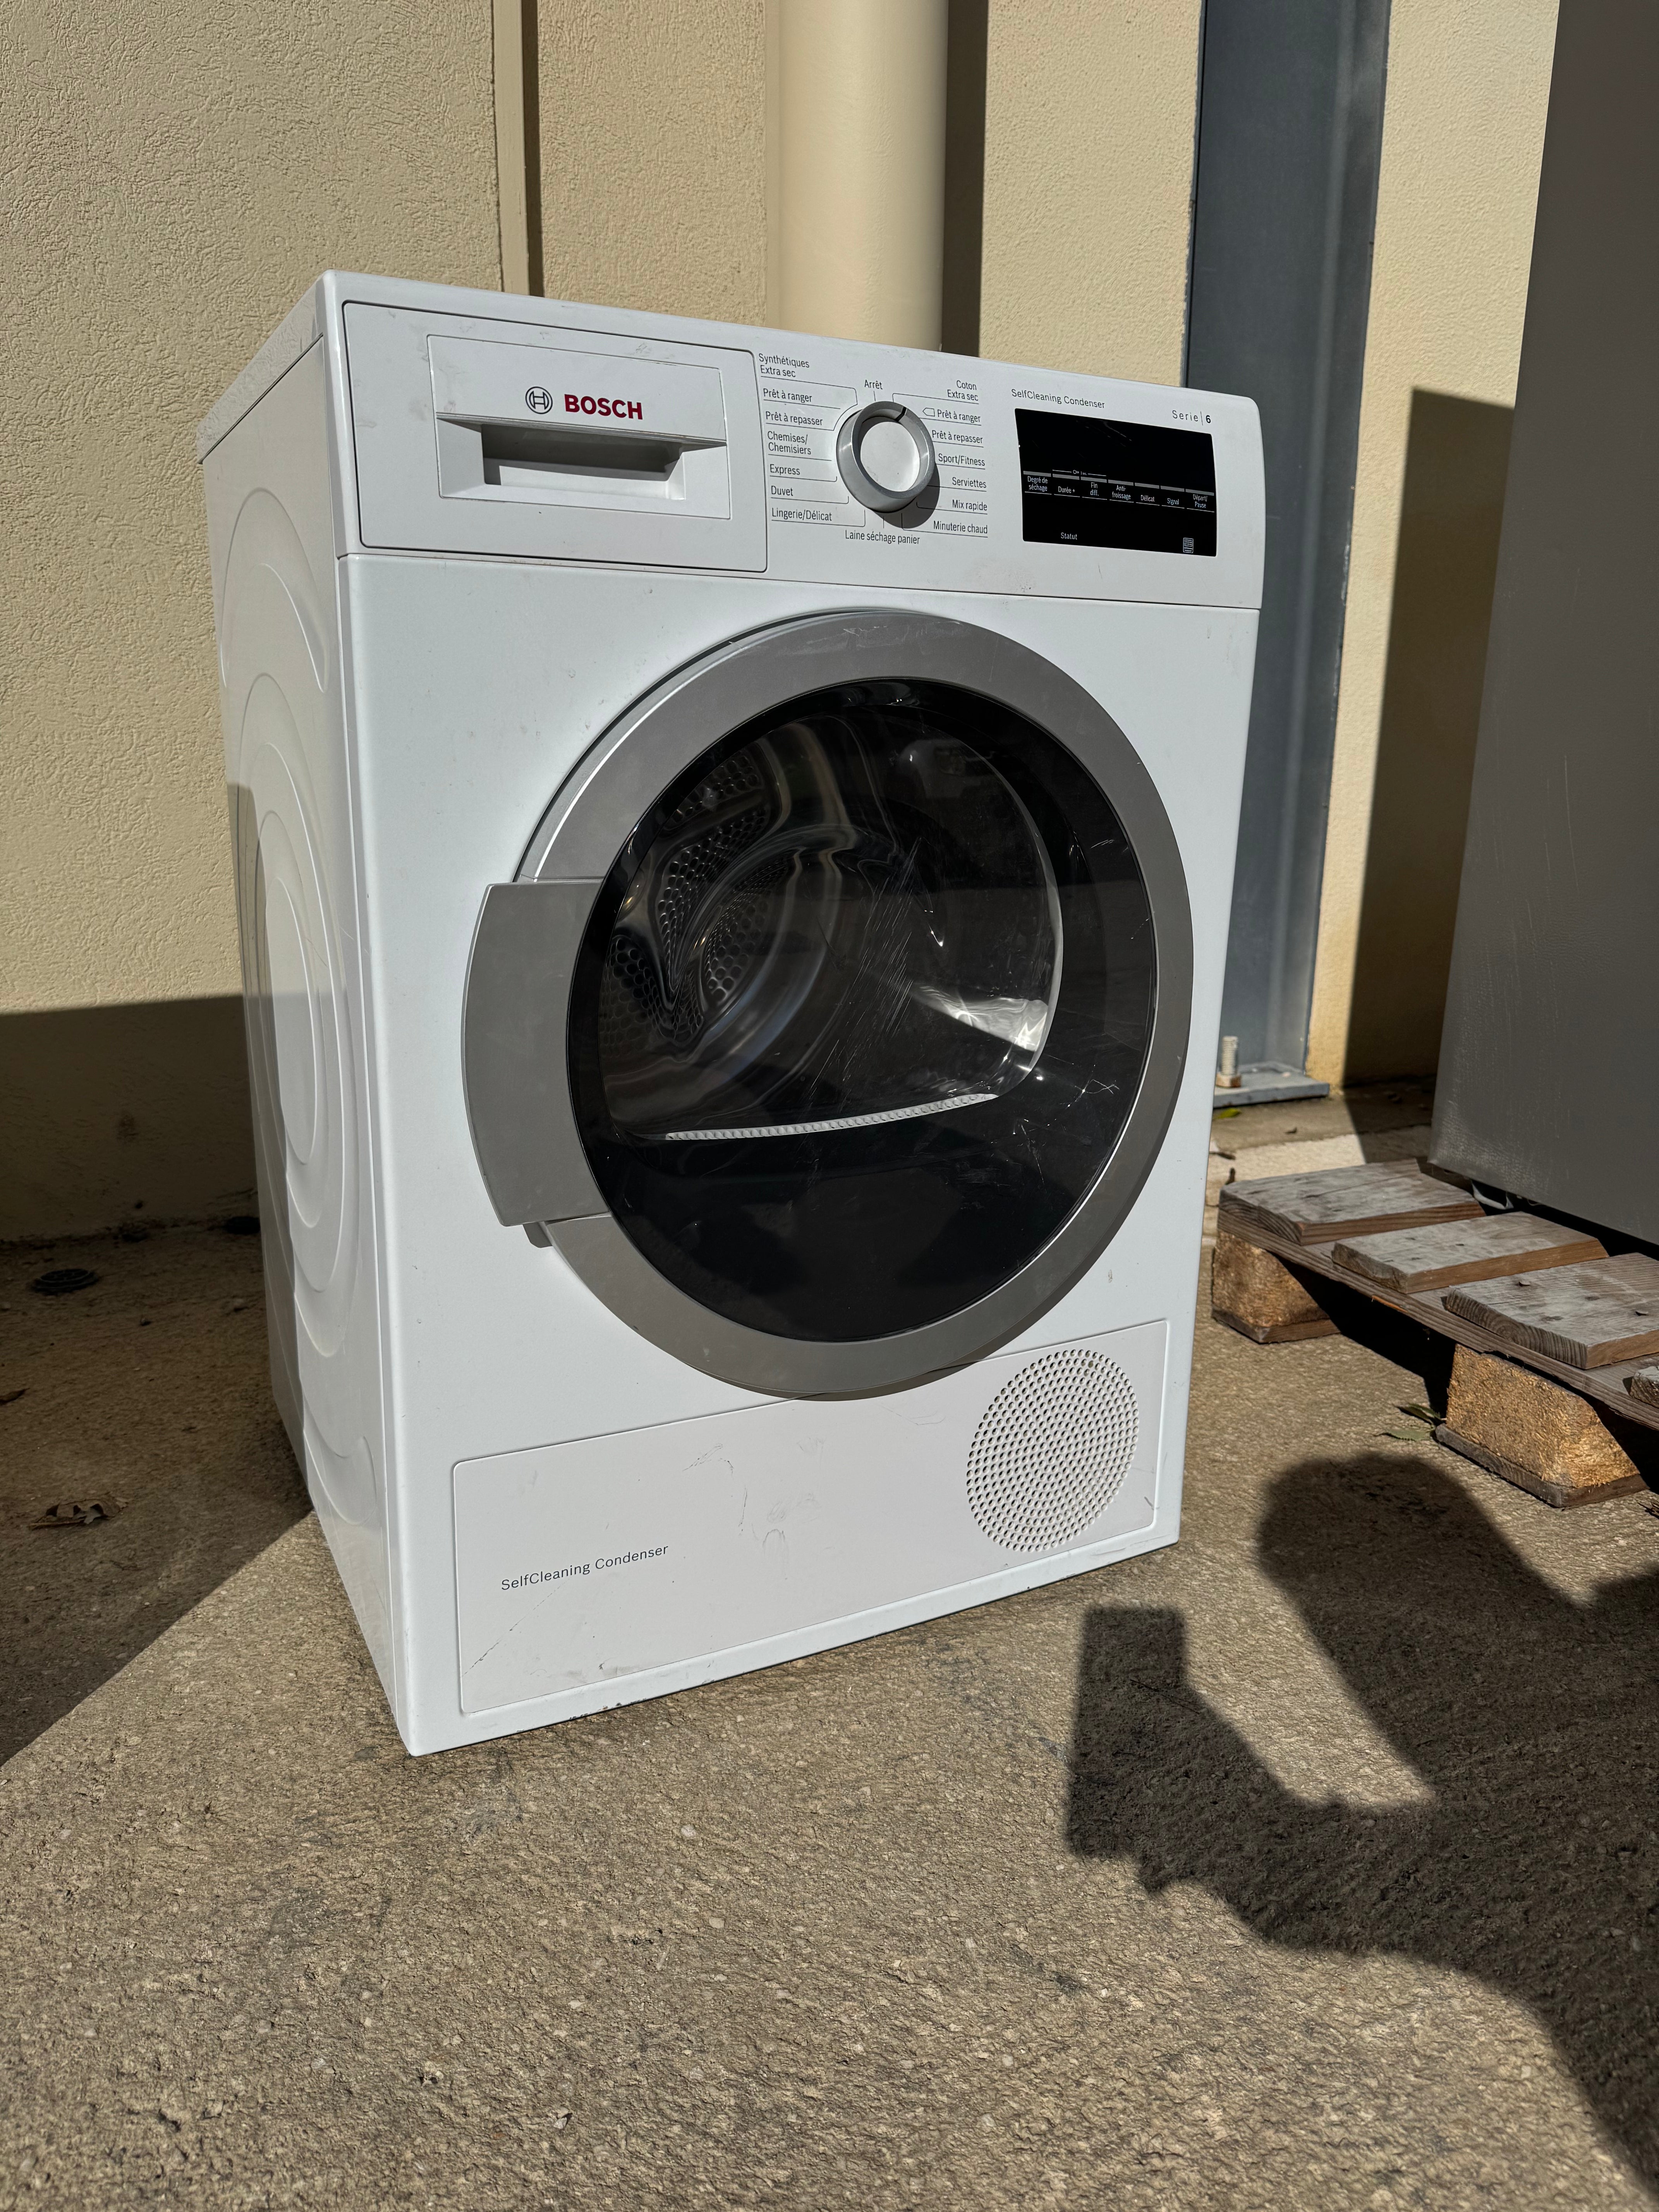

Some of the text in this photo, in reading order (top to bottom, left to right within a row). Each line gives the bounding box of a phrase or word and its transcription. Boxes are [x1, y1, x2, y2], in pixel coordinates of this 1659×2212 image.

[759, 354, 809, 368] Synthétiques
[761, 365, 781, 375] Extra
[865, 380, 883, 389] Arrêt
[957, 380, 976, 390] Coton
[763, 388, 812, 403] Prêt à ranger
[947, 390, 965, 399] Extra
[1012, 389, 1104, 408] SelfCleaning Condenser
[565, 394, 642, 419] BOSCH
[766, 411, 823, 425] Prêt à repasser
[938, 409, 951, 419] Prêt
[959, 414, 980, 423] ranger
[1173, 410, 1211, 423] Serie 6
[768, 431, 808, 445] Chemises/
[932, 430, 982, 443] Prêt à repasser
[768, 442, 811, 455] Chemisiers
[938, 453, 986, 467] Sport/Fitness
[770, 464, 800, 475] Express
[953, 477, 986, 488] Serviettes
[1027, 476, 1041, 485] Degré
[771, 486, 793, 496] Duvet
[1029, 484, 1048, 492] séchage
[1112, 491, 1131, 500] froissage
[953, 500, 987, 511] Mix rapide
[772, 508, 831, 521] Lingerie/Délicat
[934, 521, 987, 534] Minuterie chaud
[846, 530, 920, 544] Laine séchage panier
[502, 1546, 668, 1590] SelfCleaning Condenser
